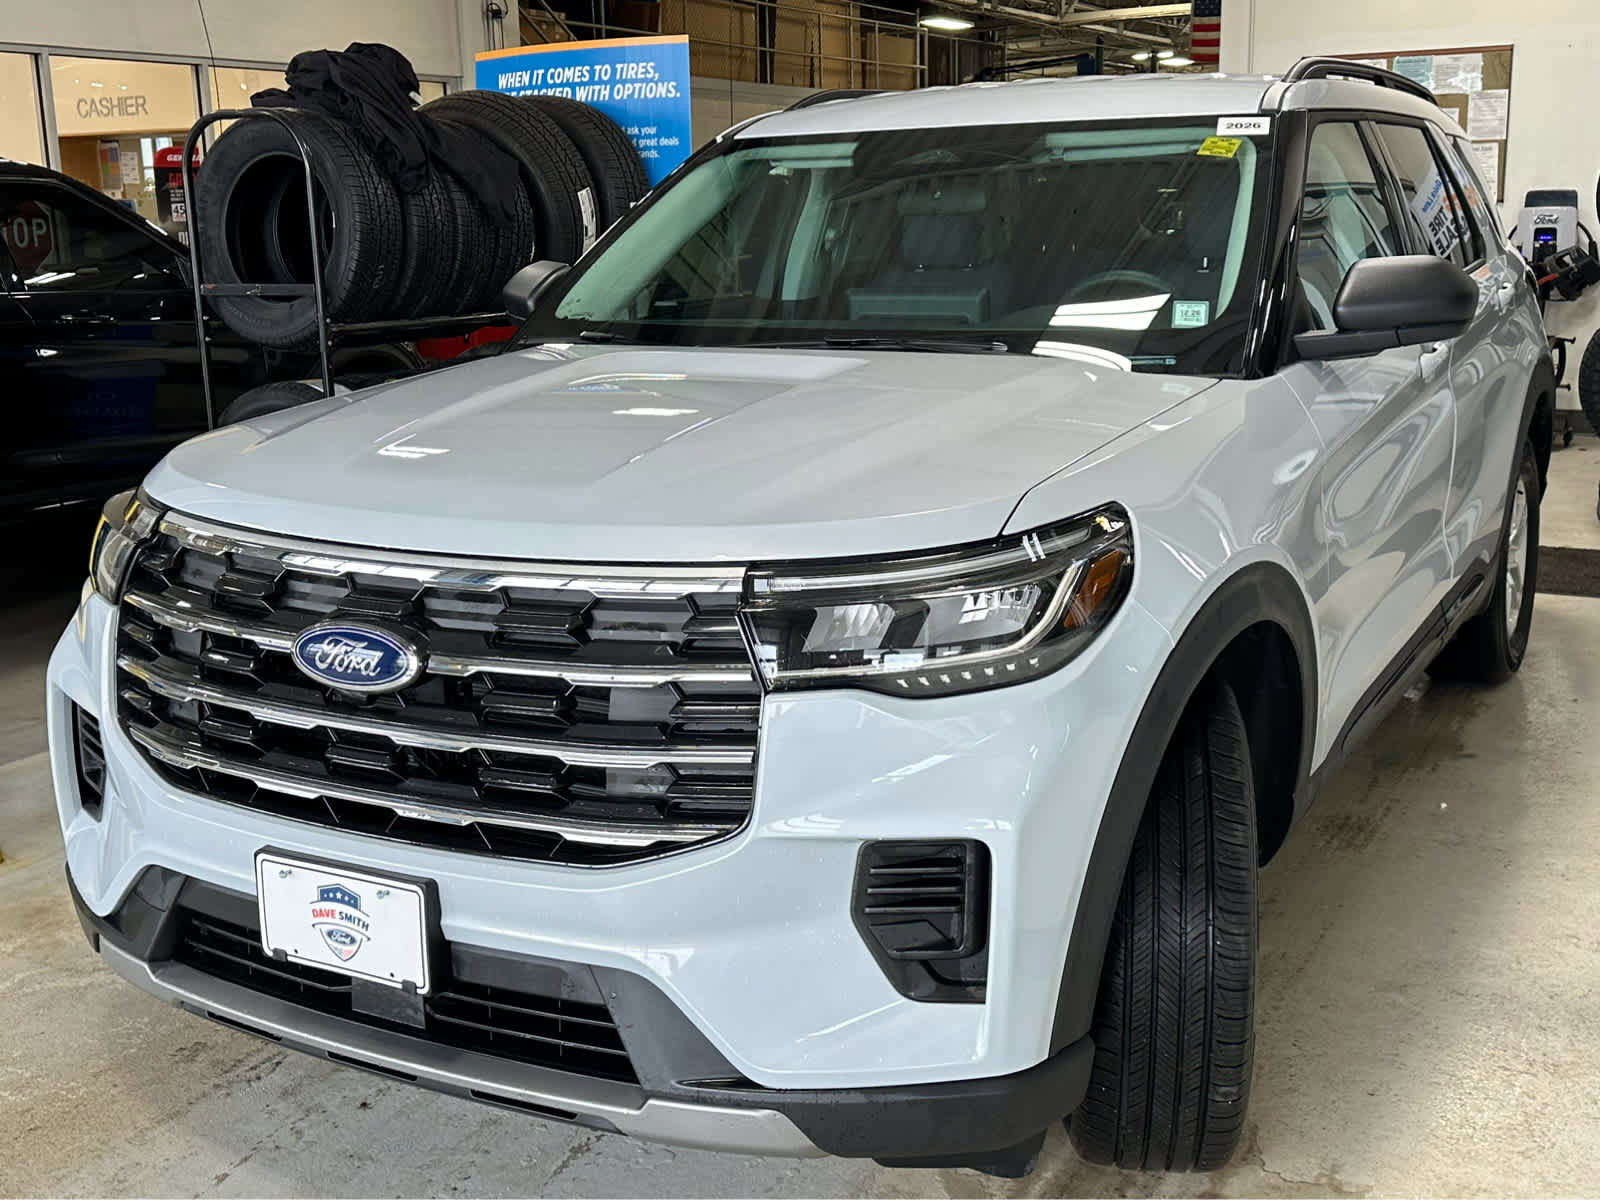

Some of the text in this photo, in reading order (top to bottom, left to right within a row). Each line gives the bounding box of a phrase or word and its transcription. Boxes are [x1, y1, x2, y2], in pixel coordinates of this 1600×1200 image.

[498, 61, 659, 89] WHEN IT COMES TO TIRES,
[575, 84, 610, 102] WITH
[613, 81, 681, 100] OPTIONS.
[76, 95, 148, 119] CASHIER
[627, 125, 640, 135] ask
[640, 126, 657, 137] your
[638, 137, 658, 148] great
[659, 136, 679, 146] deals
[638, 149, 661, 158] ands.
[1534, 214, 1560, 225] Ford
[7, 217, 47, 248] OP
[311, 636, 384, 676] Ford
[311, 908, 370, 932] DAVE SMITH
